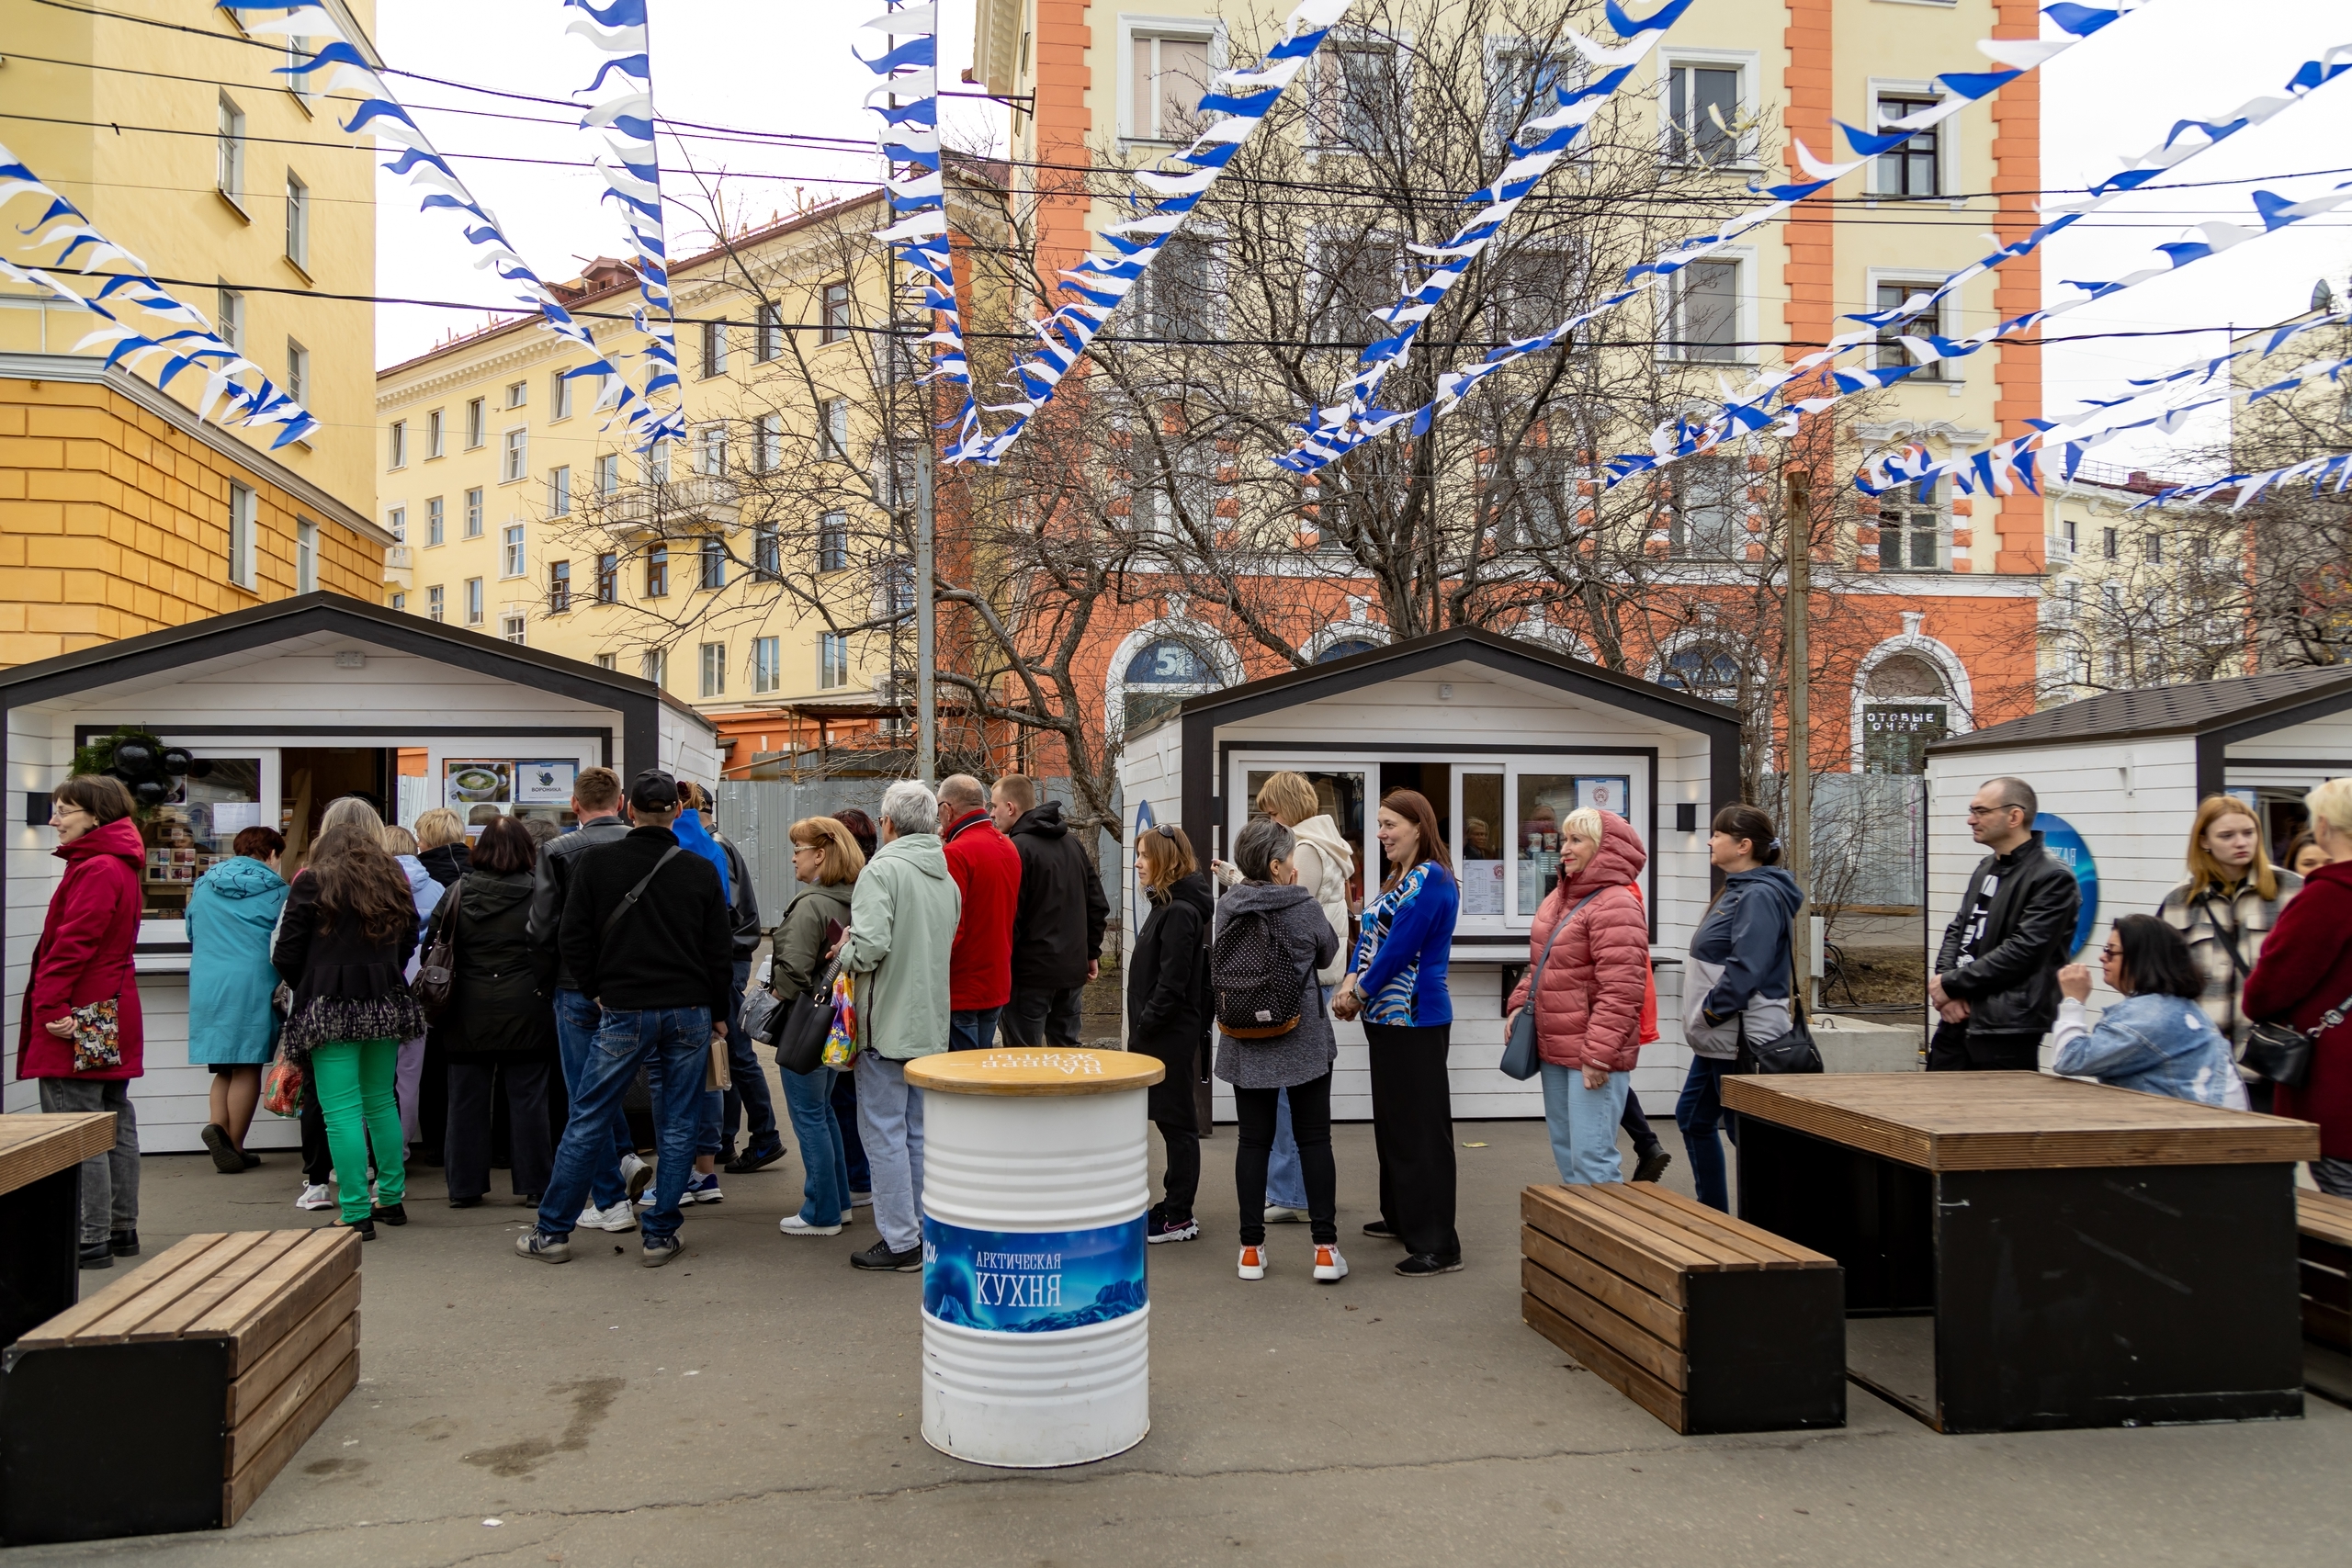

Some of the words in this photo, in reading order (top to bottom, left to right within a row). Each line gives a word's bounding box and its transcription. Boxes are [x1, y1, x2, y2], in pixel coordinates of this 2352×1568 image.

[982, 1059, 1102, 1068] СЕВЕРЕ
[1059, 1066, 1105, 1075] НА
[976, 1251, 1062, 1270] АРКТИЧЕСКАЯ
[976, 1271, 1062, 1307] КУХНЯ
